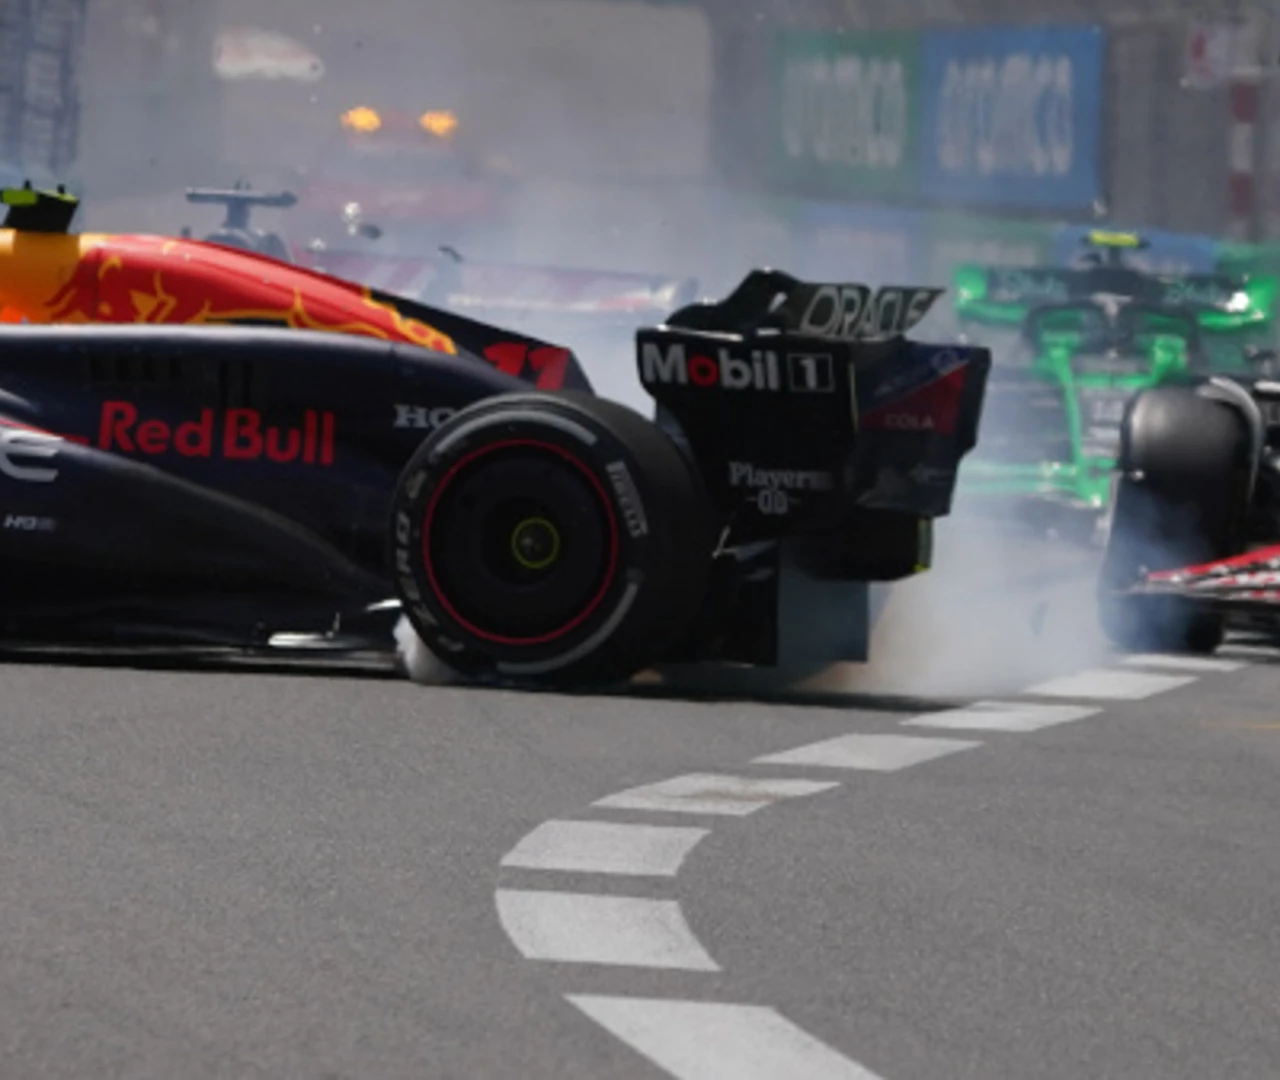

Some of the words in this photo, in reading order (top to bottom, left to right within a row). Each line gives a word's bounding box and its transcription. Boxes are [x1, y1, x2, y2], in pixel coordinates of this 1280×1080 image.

[641, 342, 780, 391] Mobil
[98, 400, 213, 457] Red
[222, 408, 335, 465] Bull
